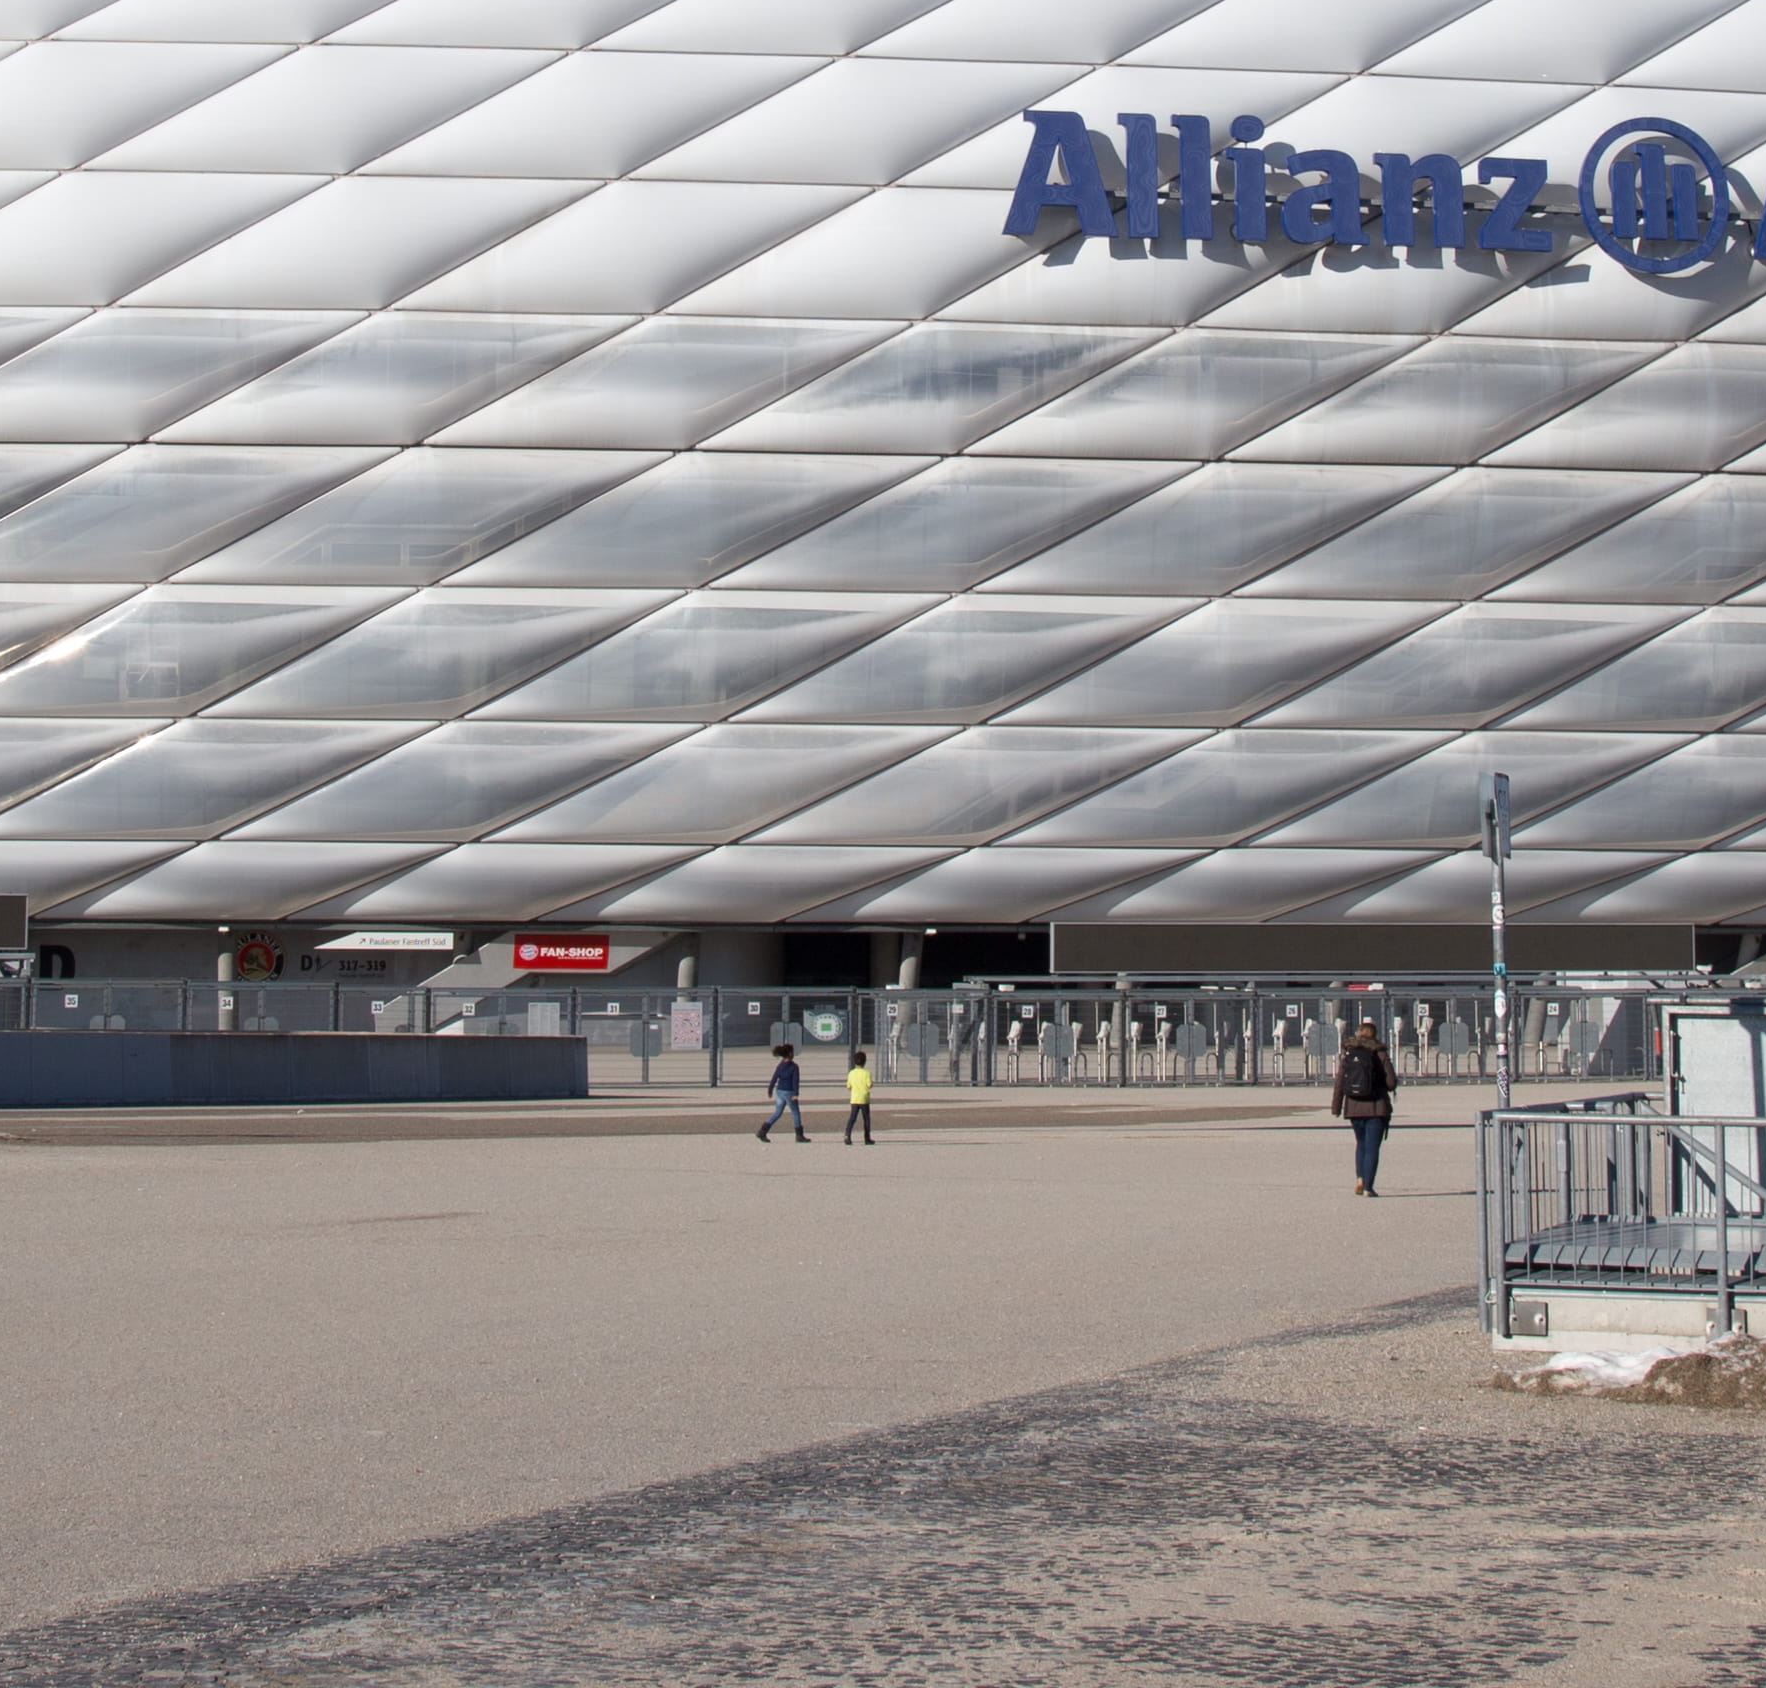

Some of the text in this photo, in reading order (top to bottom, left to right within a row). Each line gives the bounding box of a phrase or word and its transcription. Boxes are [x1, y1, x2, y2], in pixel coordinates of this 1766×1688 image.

[1002, 110, 1552, 253] Allianz
[540, 947, 603, 957] FAN-SHOP
[300, 955, 386, 972] D 317-319
[66, 997, 76, 1005] 35
[222, 999, 232, 1007] 34
[372, 1003, 382, 1012] 33
[609, 1004, 618, 1013] 31
[888, 1006, 897, 1014] 29
